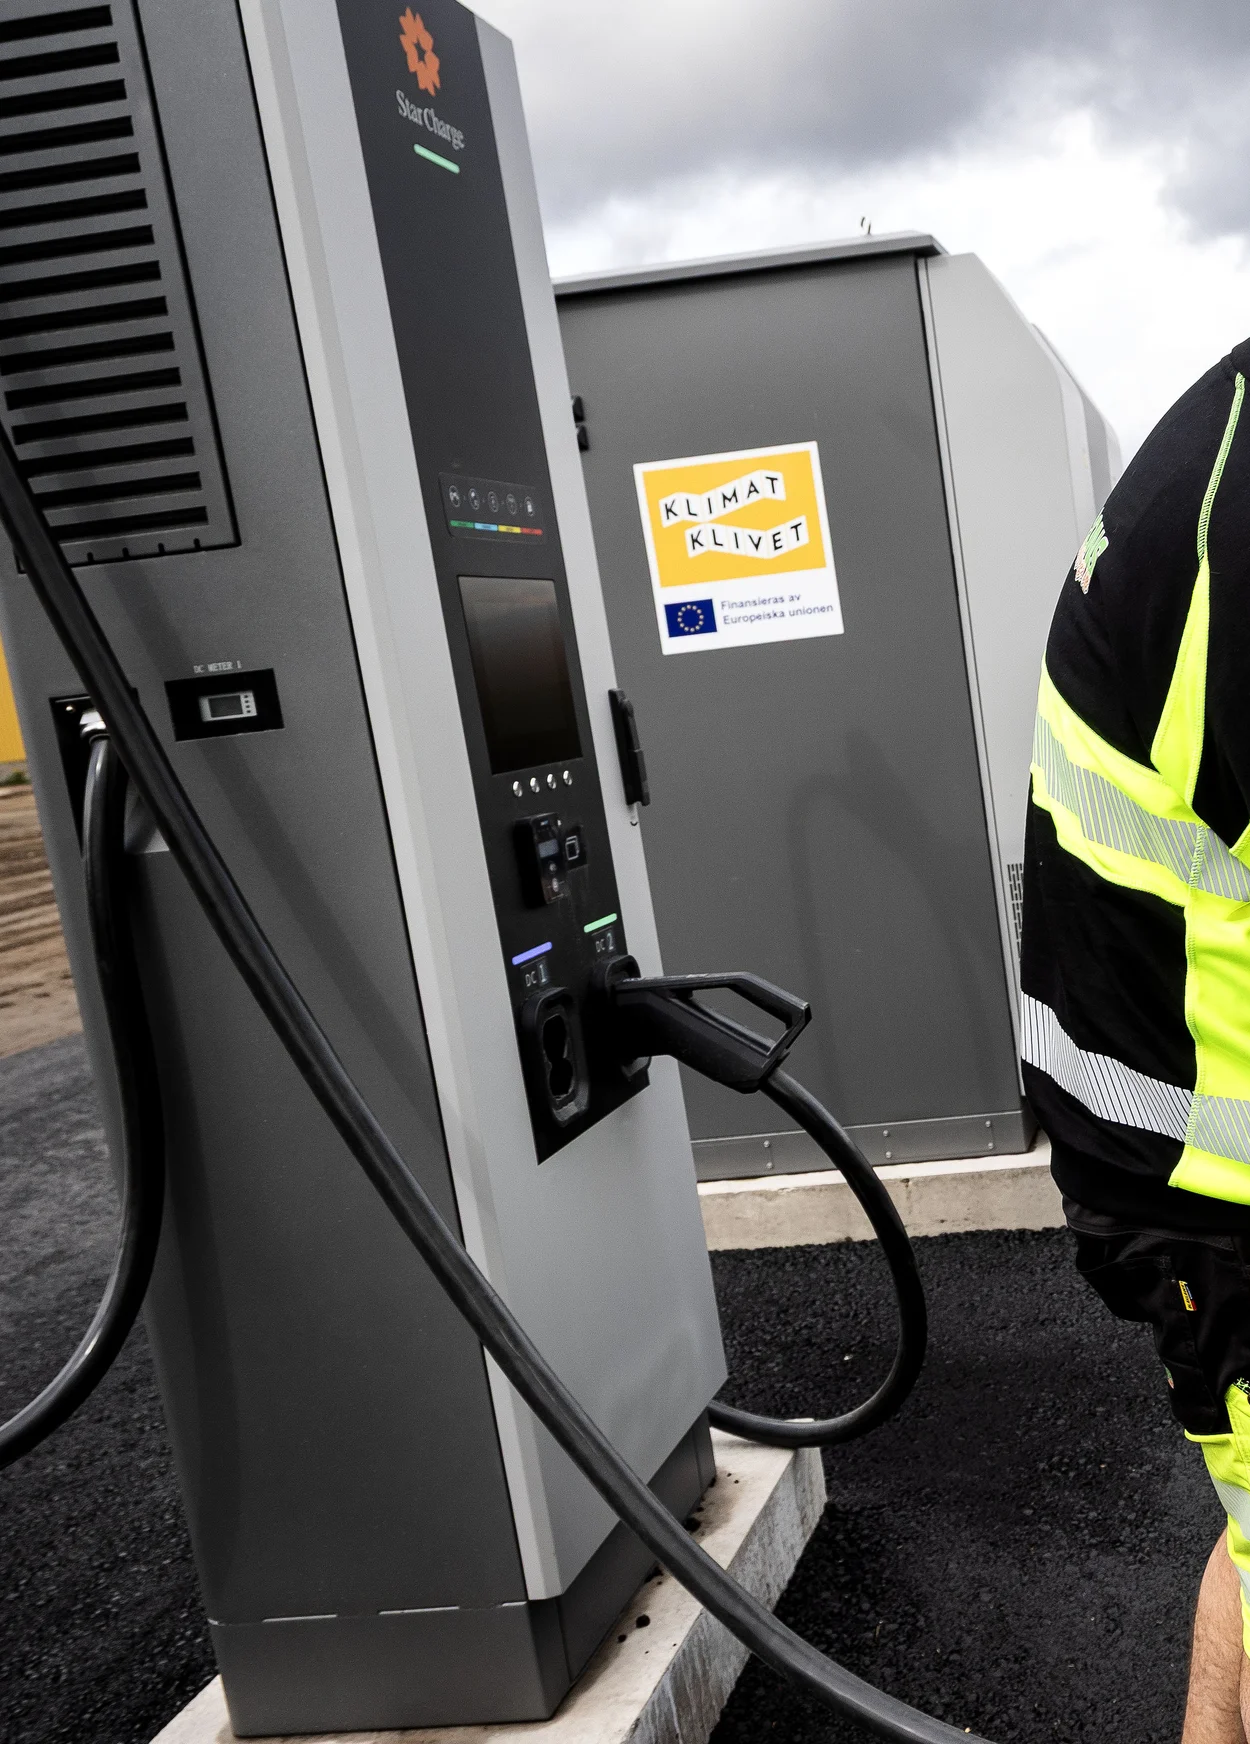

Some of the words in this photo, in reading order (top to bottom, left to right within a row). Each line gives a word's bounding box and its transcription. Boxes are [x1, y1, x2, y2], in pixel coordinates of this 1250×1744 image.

[664, 476, 778, 520] KLIMAT
[690, 522, 802, 551] KLIVET
[721, 595, 785, 611] Finansieras
[788, 593, 801, 603] av
[723, 608, 785, 625] Europeiska
[789, 603, 834, 618] unionen
[207, 661, 233, 672] METER
[595, 938, 606, 953] DC
[606, 932, 615, 951] 2
[524, 971, 537, 987] DC
[539, 963, 548, 983] 1
